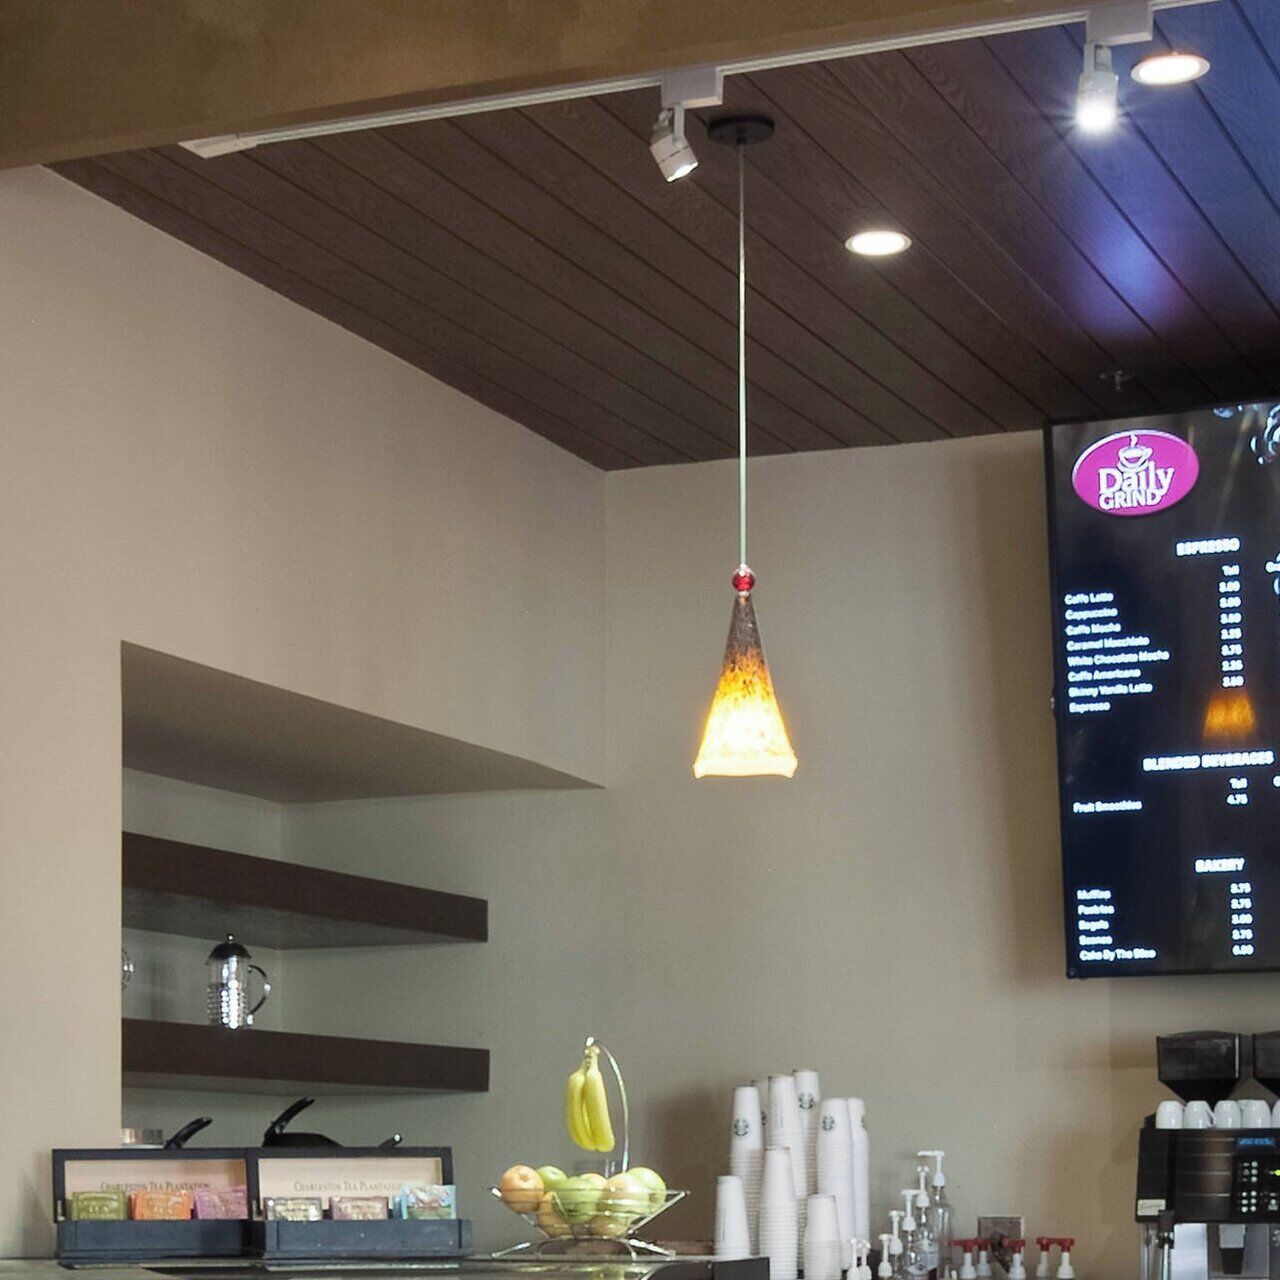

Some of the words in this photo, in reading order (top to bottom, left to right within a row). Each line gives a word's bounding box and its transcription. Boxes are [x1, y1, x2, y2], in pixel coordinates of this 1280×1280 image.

[1098, 460, 1175, 496] Daily
[1098, 488, 1162, 510] GRIND
[360, 1181, 401, 1192] PLANTATIO
